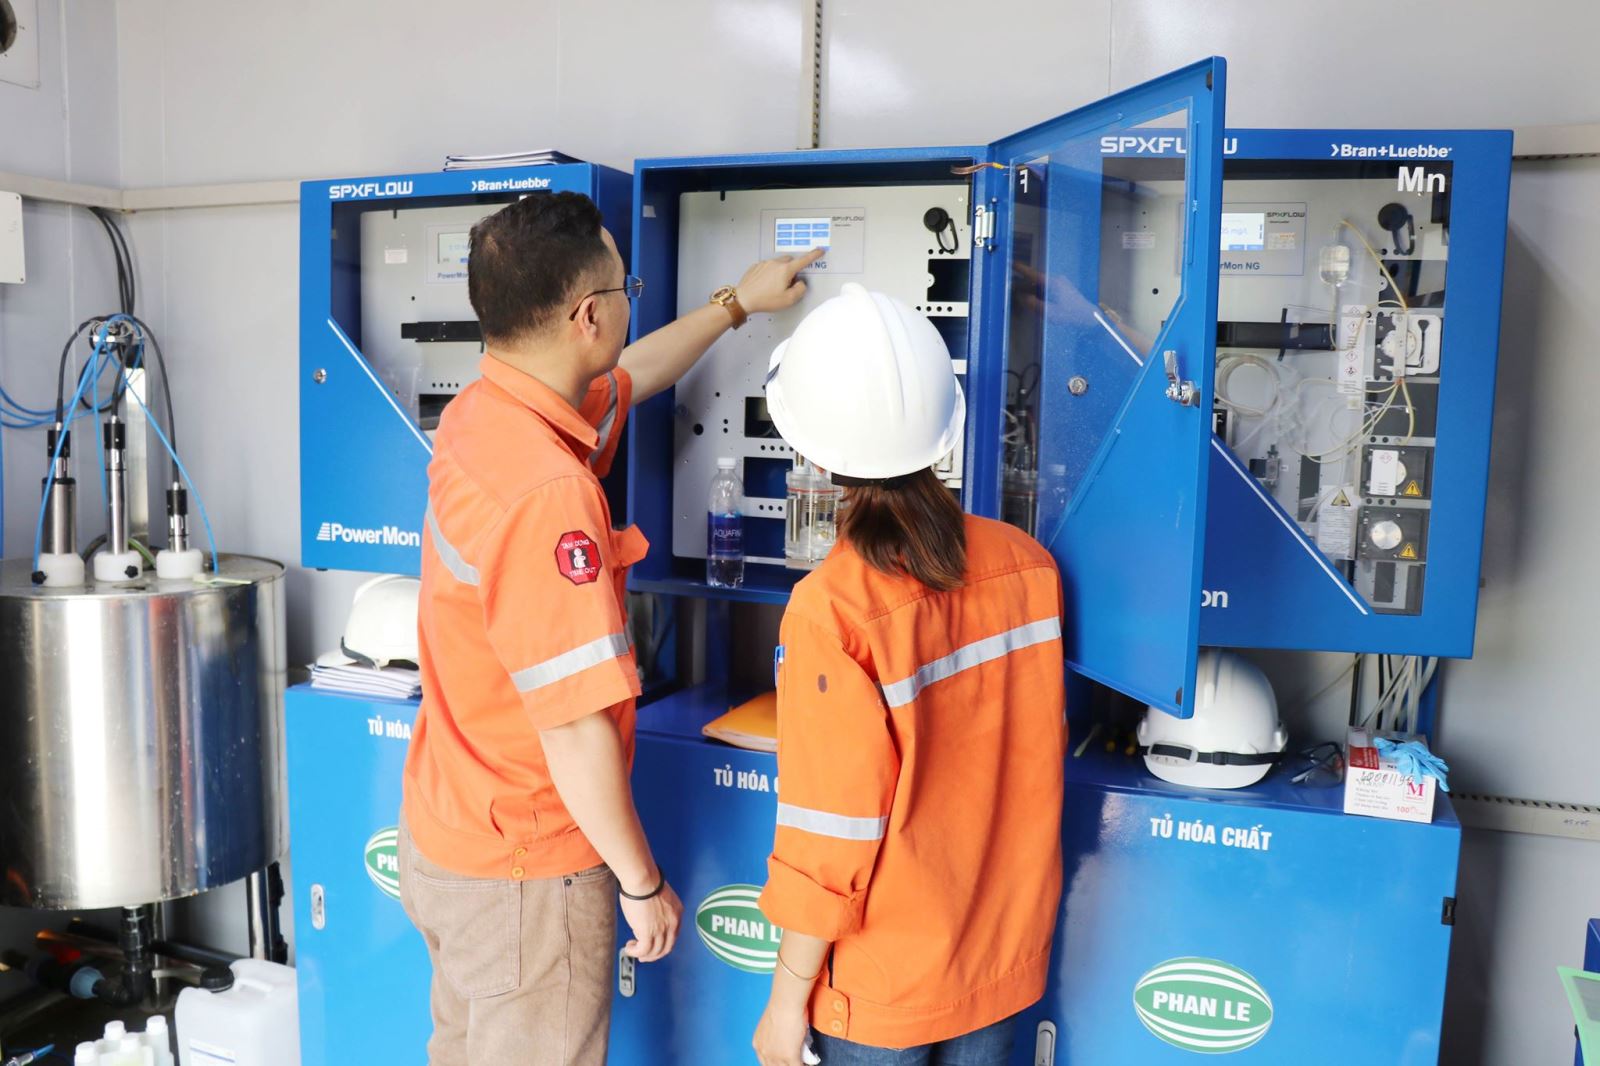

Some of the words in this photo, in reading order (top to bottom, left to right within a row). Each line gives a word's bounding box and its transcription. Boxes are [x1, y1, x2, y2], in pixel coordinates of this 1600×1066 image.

[329, 181, 413, 199] SPXFLOW
[1397, 166, 1446, 192] Mn
[1245, 262, 1260, 270] NG
[331, 523, 420, 547] PowerMon
[368, 715, 384, 736] TỦ
[386, 719, 411, 739] HÓA
[714, 764, 733, 787] TỦ
[737, 770, 769, 792] HÓA
[1150, 813, 1173, 838] TỦ
[1178, 820, 1216, 845] HÓA
[1222, 824, 1273, 851] CHẤT
[711, 914, 764, 941] PHAN
[770, 927, 781, 943] L
[1153, 990, 1216, 1018] PHAN
[1224, 1000, 1251, 1023] LE
